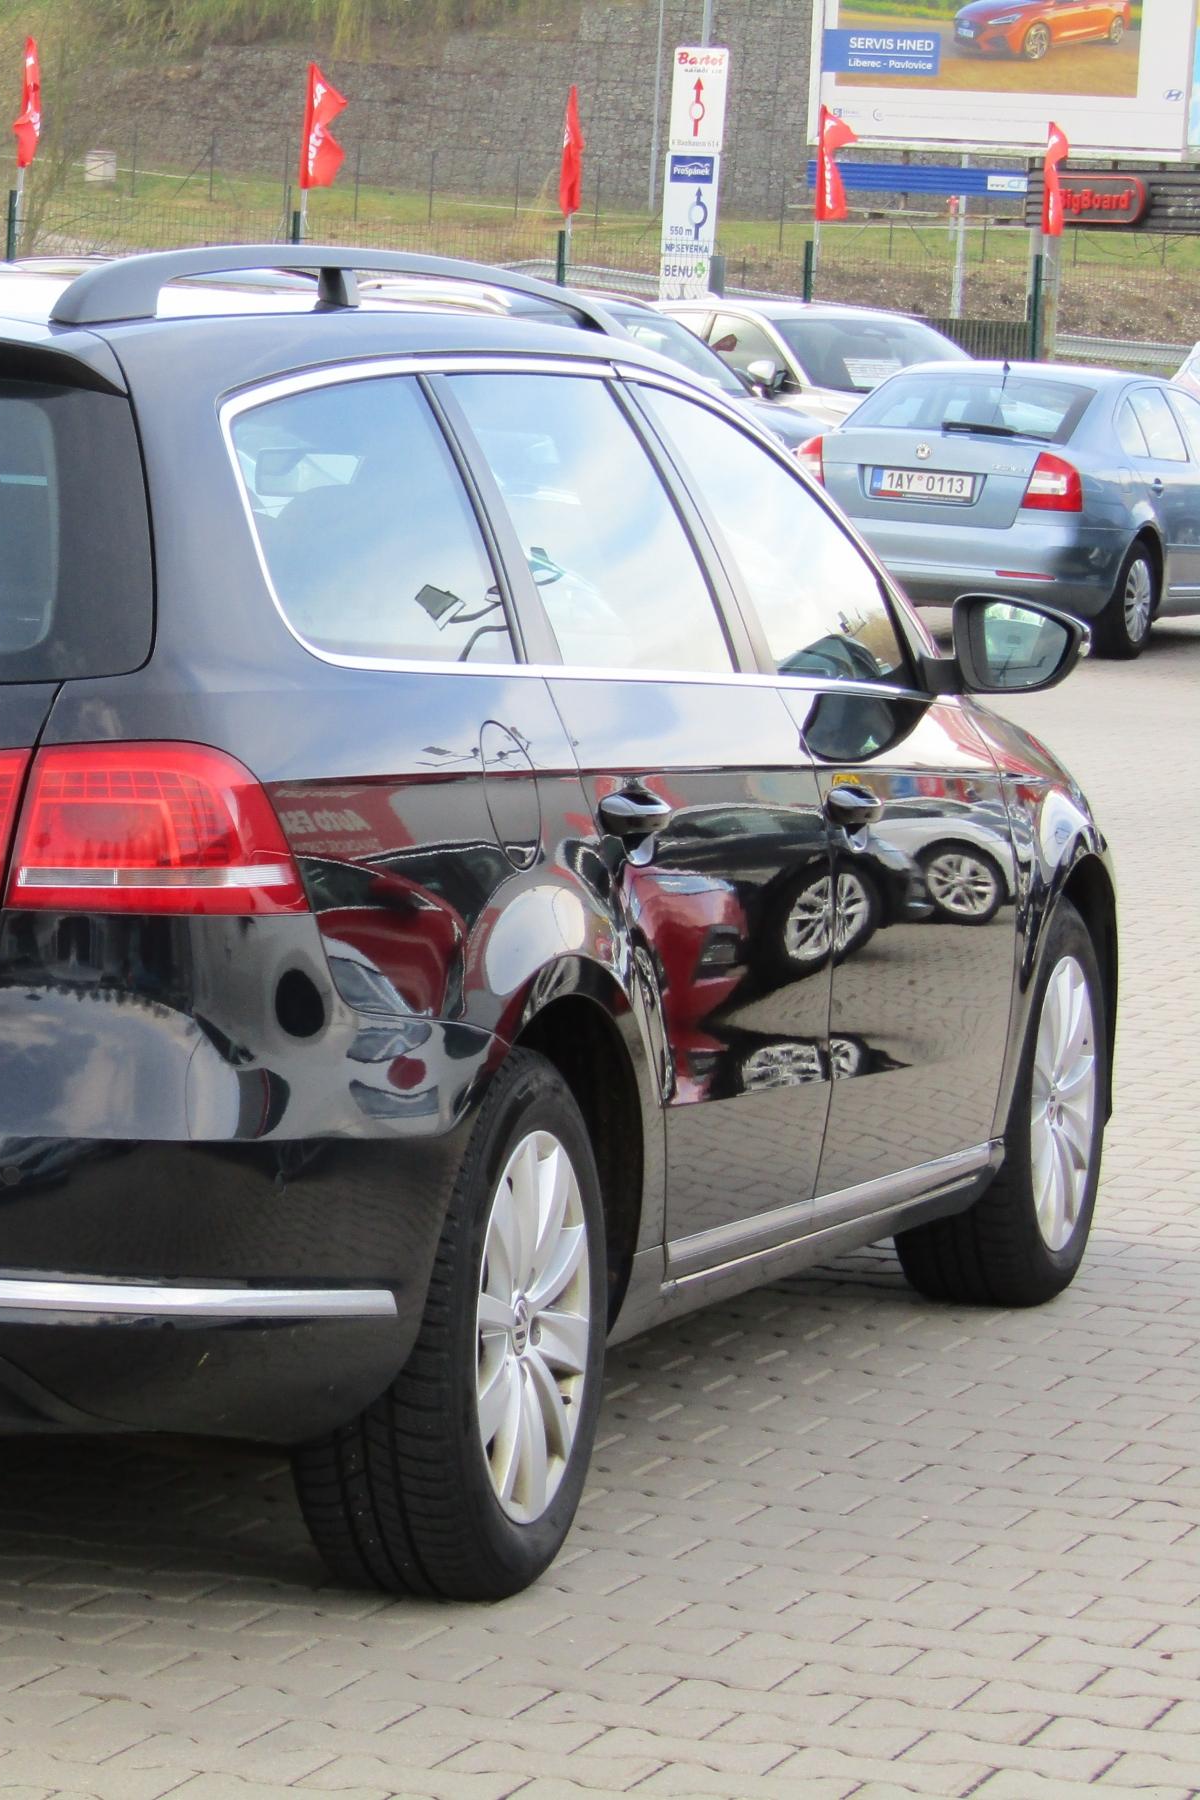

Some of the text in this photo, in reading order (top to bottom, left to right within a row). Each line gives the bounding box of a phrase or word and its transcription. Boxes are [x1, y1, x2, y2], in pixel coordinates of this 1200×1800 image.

[849, 37, 934, 51] SERVIS HNED
[848, 58, 882, 68] Liberec
[889, 59, 933, 70] Pavlovice
[673, 166, 710, 177] ProSpánek
[670, 225, 693, 236] 550 m
[664, 264, 693, 278] BENU
[887, 472, 965, 494] 1AY 0113
